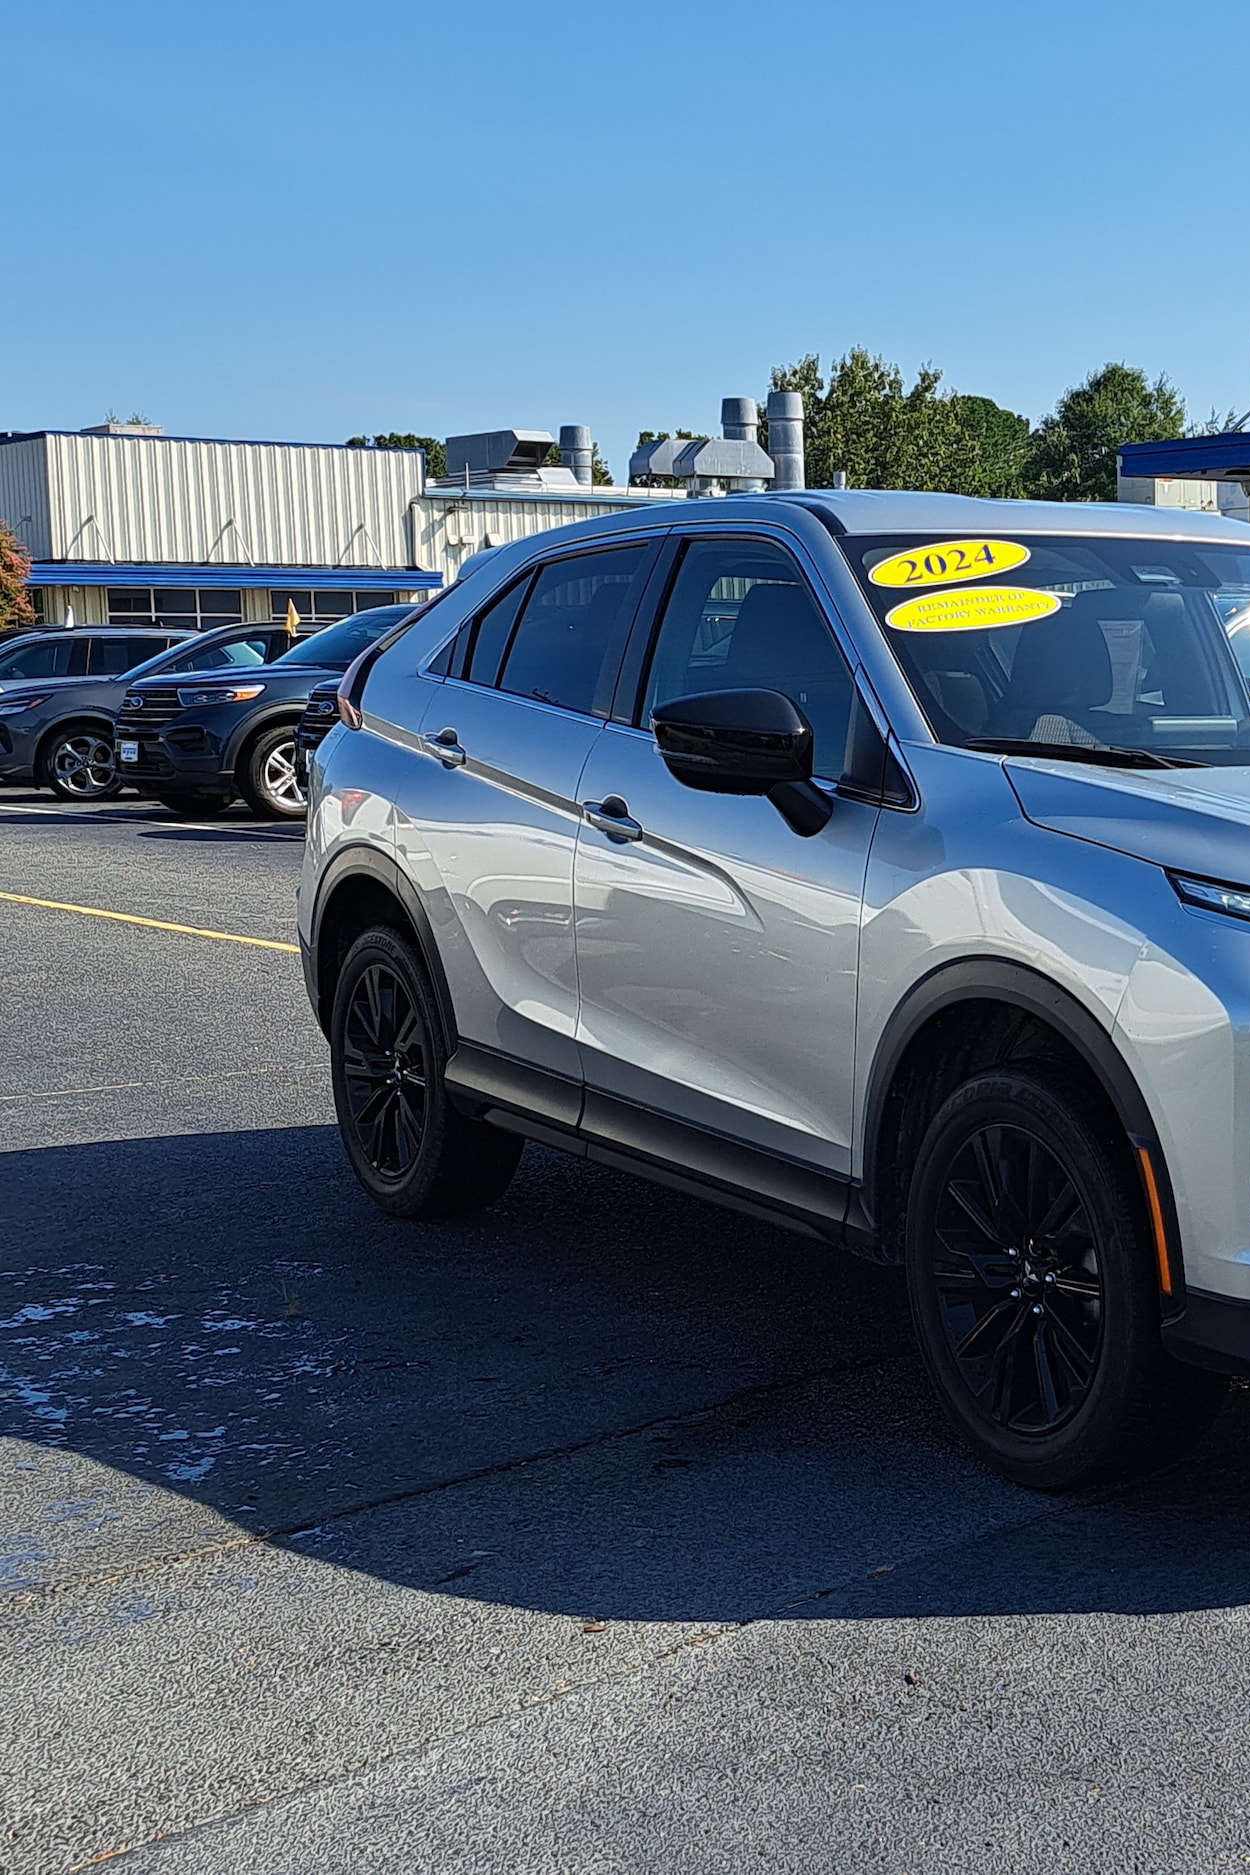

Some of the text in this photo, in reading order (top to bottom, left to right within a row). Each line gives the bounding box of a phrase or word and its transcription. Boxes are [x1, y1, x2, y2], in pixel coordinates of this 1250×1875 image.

[897, 543, 996, 584] 2024
[906, 601, 1051, 628] FACTORY WARRANTY
[916, 592, 1026, 613] REMAINDER OF
